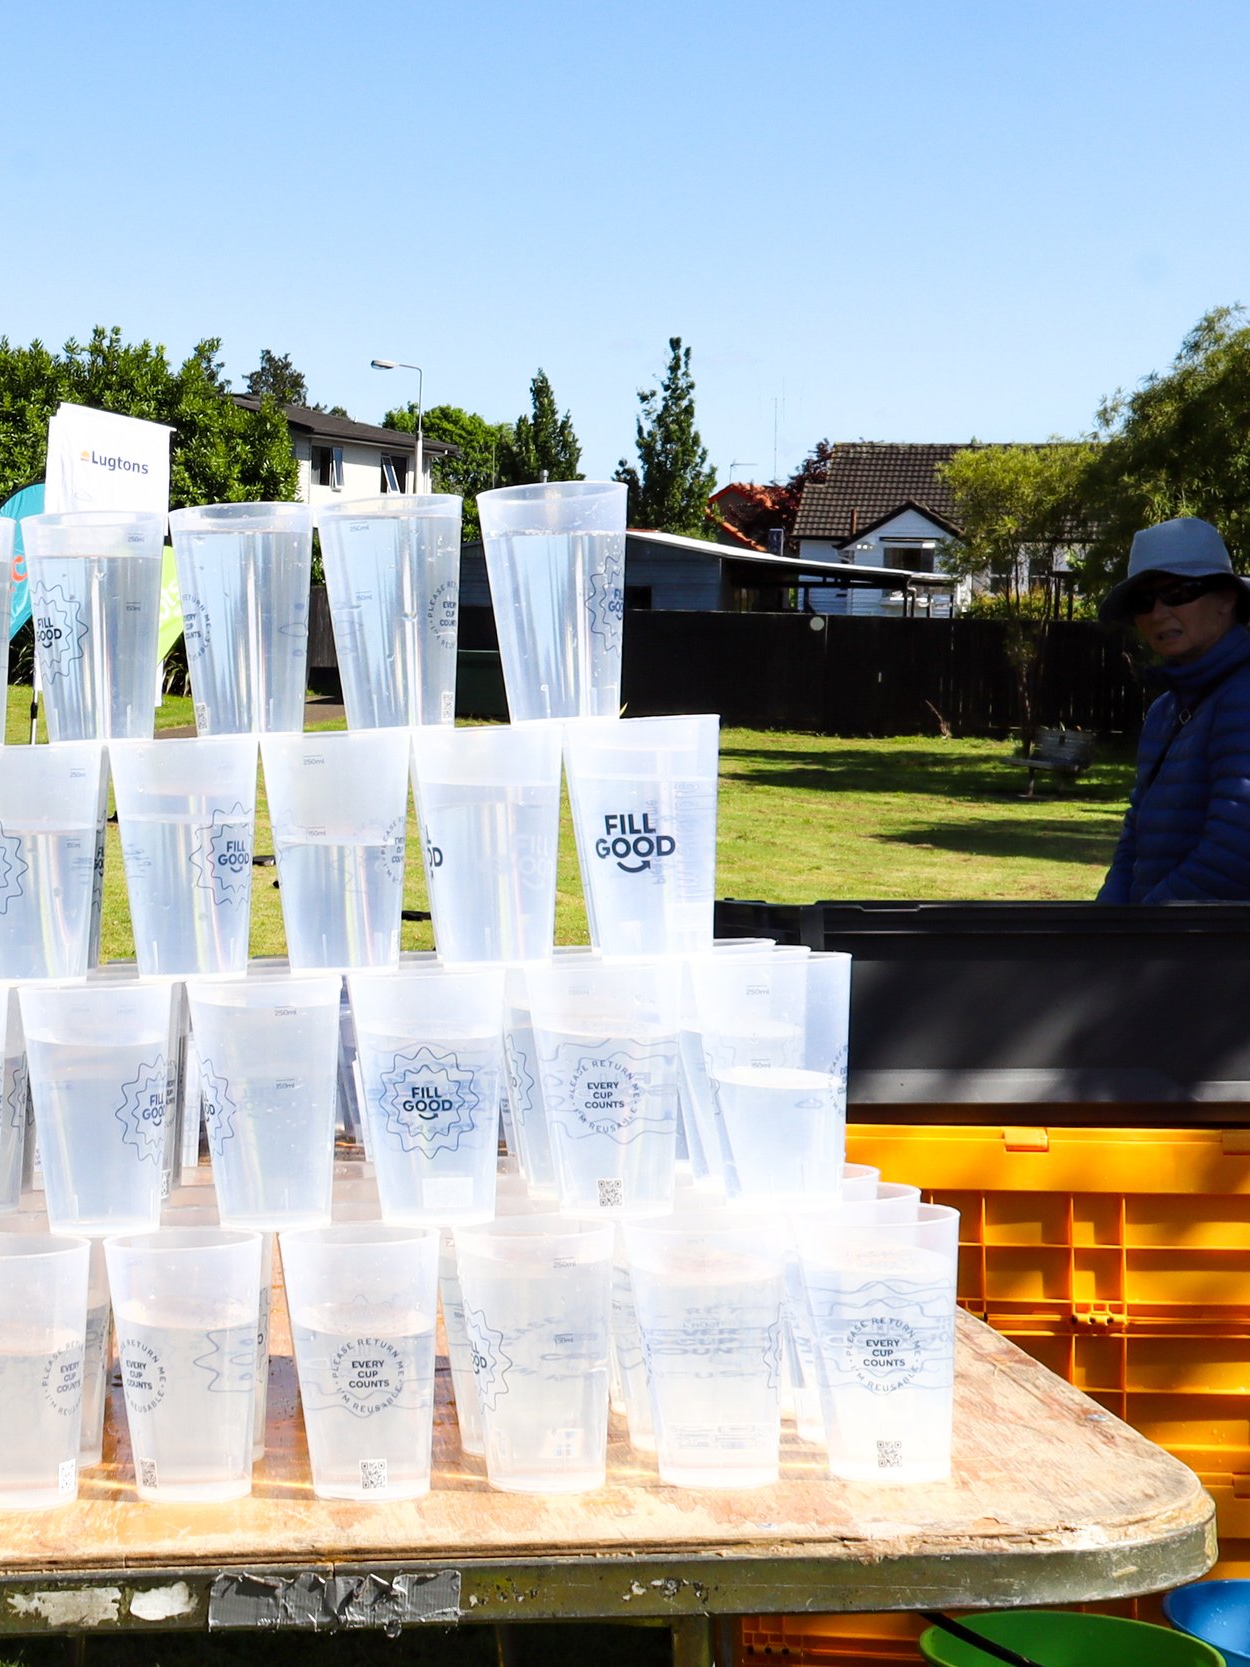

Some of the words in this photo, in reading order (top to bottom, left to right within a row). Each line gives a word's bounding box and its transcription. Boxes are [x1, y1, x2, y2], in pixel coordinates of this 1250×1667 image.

[92, 450, 149, 475] Lugtons
[37, 618, 54, 629] FILL
[36, 629, 62, 641] GOOD
[605, 813, 656, 835] FILL
[226, 841, 245, 853] FILL
[595, 835, 676, 859] GOOD
[218, 853, 250, 866] GOOD
[592, 1060, 634, 1081] RETURN
[587, 1082, 619, 1090] EVERY
[411, 1087, 442, 1099] FILL
[593, 1091, 613, 1099] CUP
[403, 1100, 453, 1112] GOOD
[585, 1101, 624, 1109] COUNTS
[142, 1105, 166, 1120] GOO
[846, 1320, 868, 1356] PLEASE
[871, 1317, 916, 1338] RETURN
[913, 1340, 921, 1356] ME
[865, 1339, 900, 1347] EVERY
[332, 1342, 354, 1378] PLEASE
[357, 1338, 399, 1358] RETURN
[396, 1361, 404, 1377] ME
[872, 1349, 894, 1357] CUP
[126, 1339, 159, 1363] RETURN
[158, 1367, 166, 1382] ME
[126, 1360, 147, 1370] EVERY
[351, 1360, 385, 1369] EVERY
[863, 1359, 906, 1367] COUNTS
[42, 1348, 63, 1386] PLEASE
[60, 1361, 80, 1374] EVERY
[64, 1373, 76, 1382] CUP
[130, 1371, 143, 1379] CUP
[357, 1370, 378, 1378] CUP
[867, 1365, 919, 1392] REUSABLE
[126, 1379, 153, 1390] COUNTS
[348, 1379, 390, 1389] COUNTS
[130, 1391, 165, 1414] REUSABLE
[352, 1384, 402, 1413] REUSABLE
